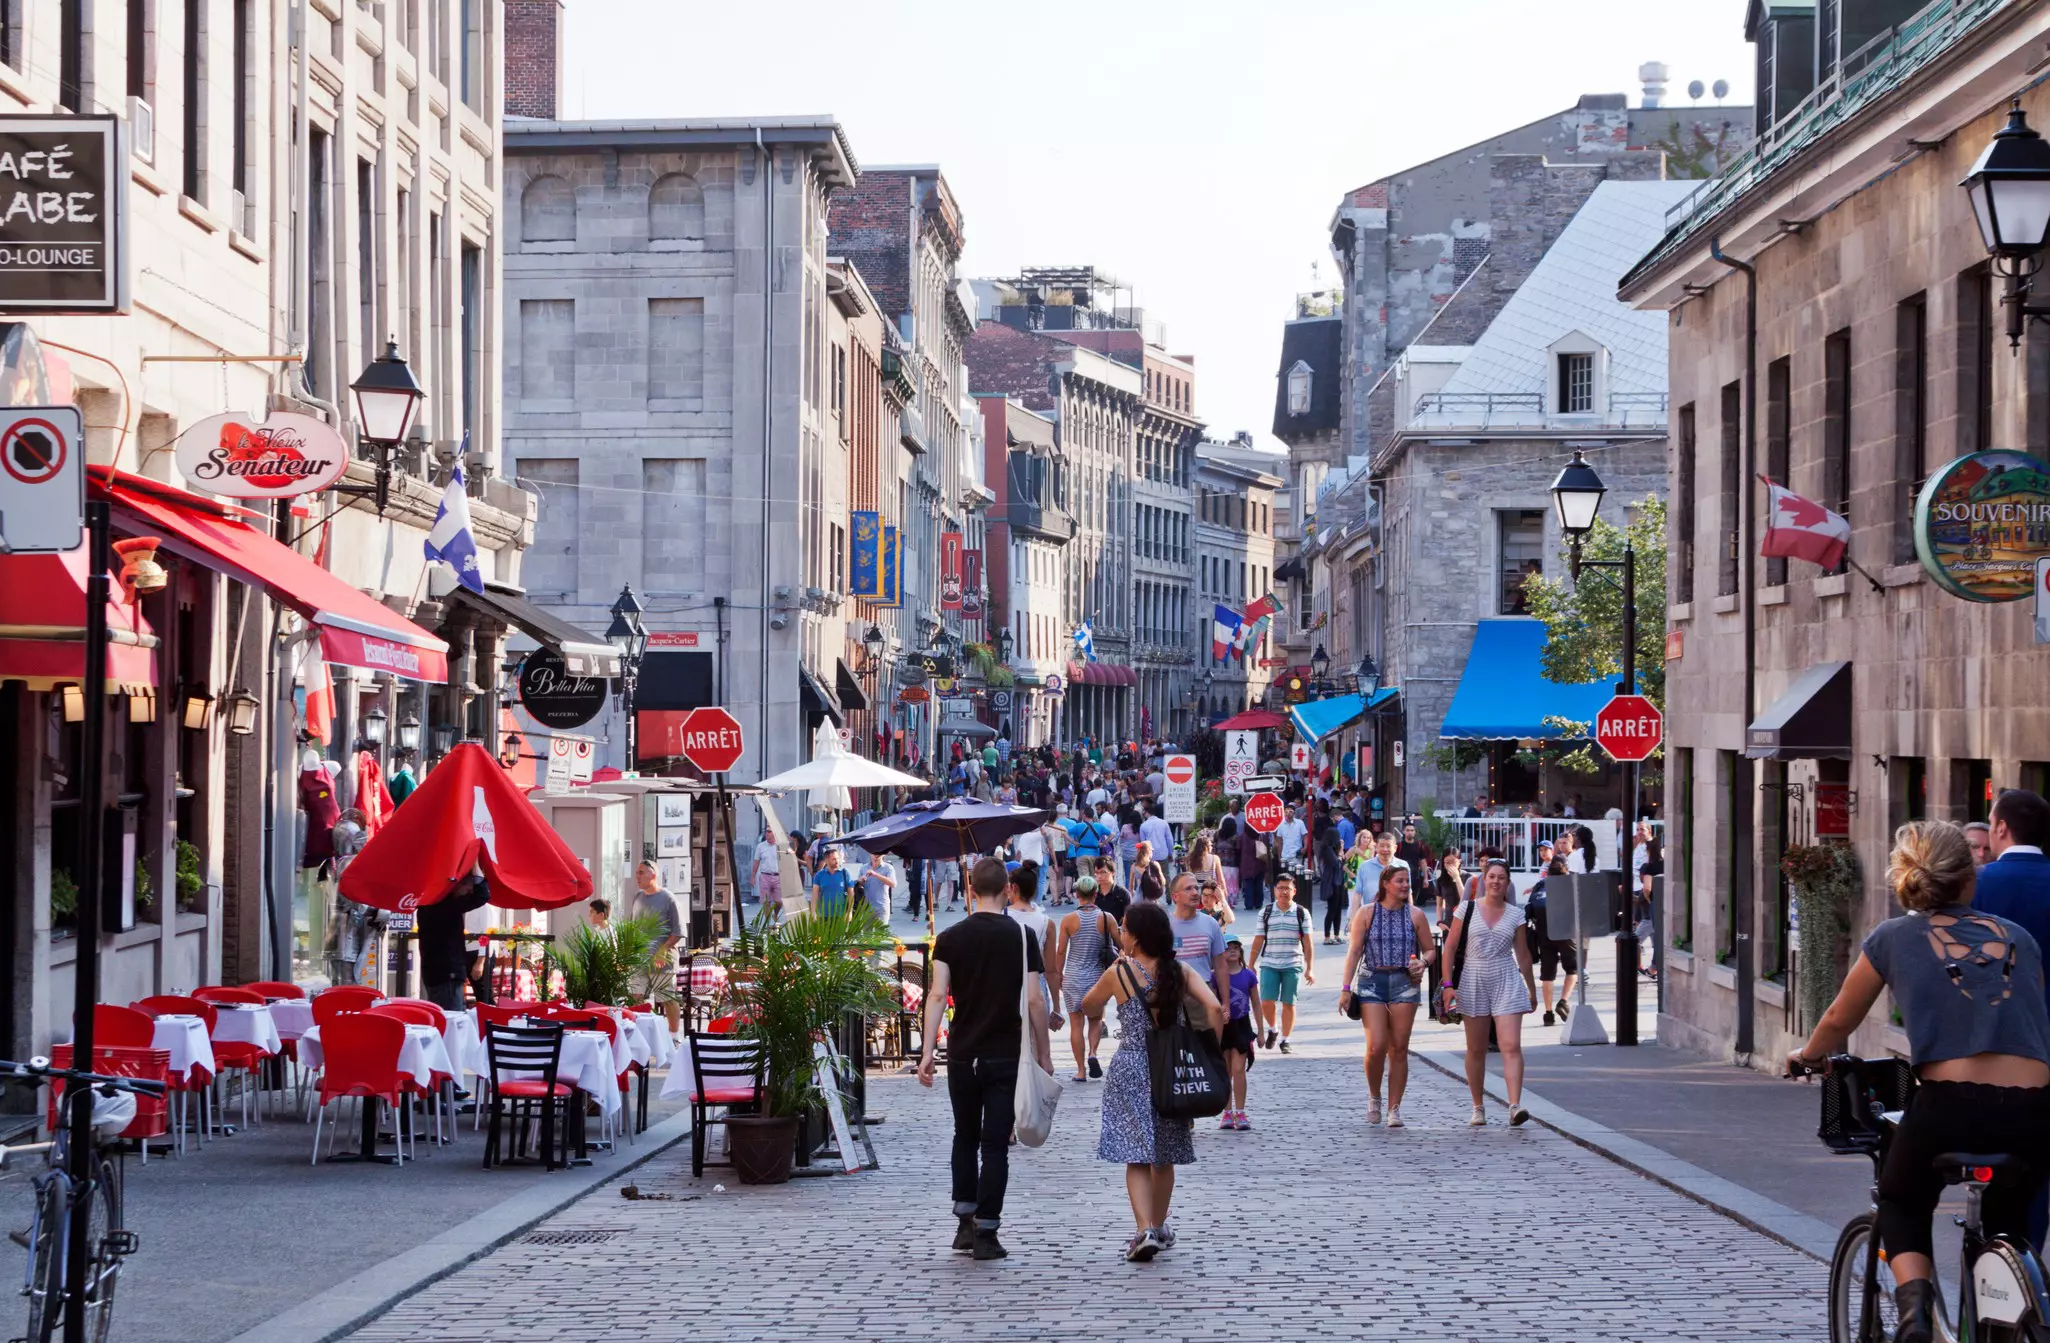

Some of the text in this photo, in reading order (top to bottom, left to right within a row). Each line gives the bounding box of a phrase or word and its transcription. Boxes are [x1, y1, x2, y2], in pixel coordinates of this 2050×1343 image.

[0, 191, 98, 227] ABE
[256, 427, 307, 449] Vieux
[194, 448, 333, 480] Senateur
[525, 667, 572, 695] Bella
[1600, 716, 1659, 737] ARRÊT
[686, 727, 739, 749] ARRÊT
[1248, 804, 1284, 820] ARRÊT
[1173, 1081, 1212, 1095] STEVE
